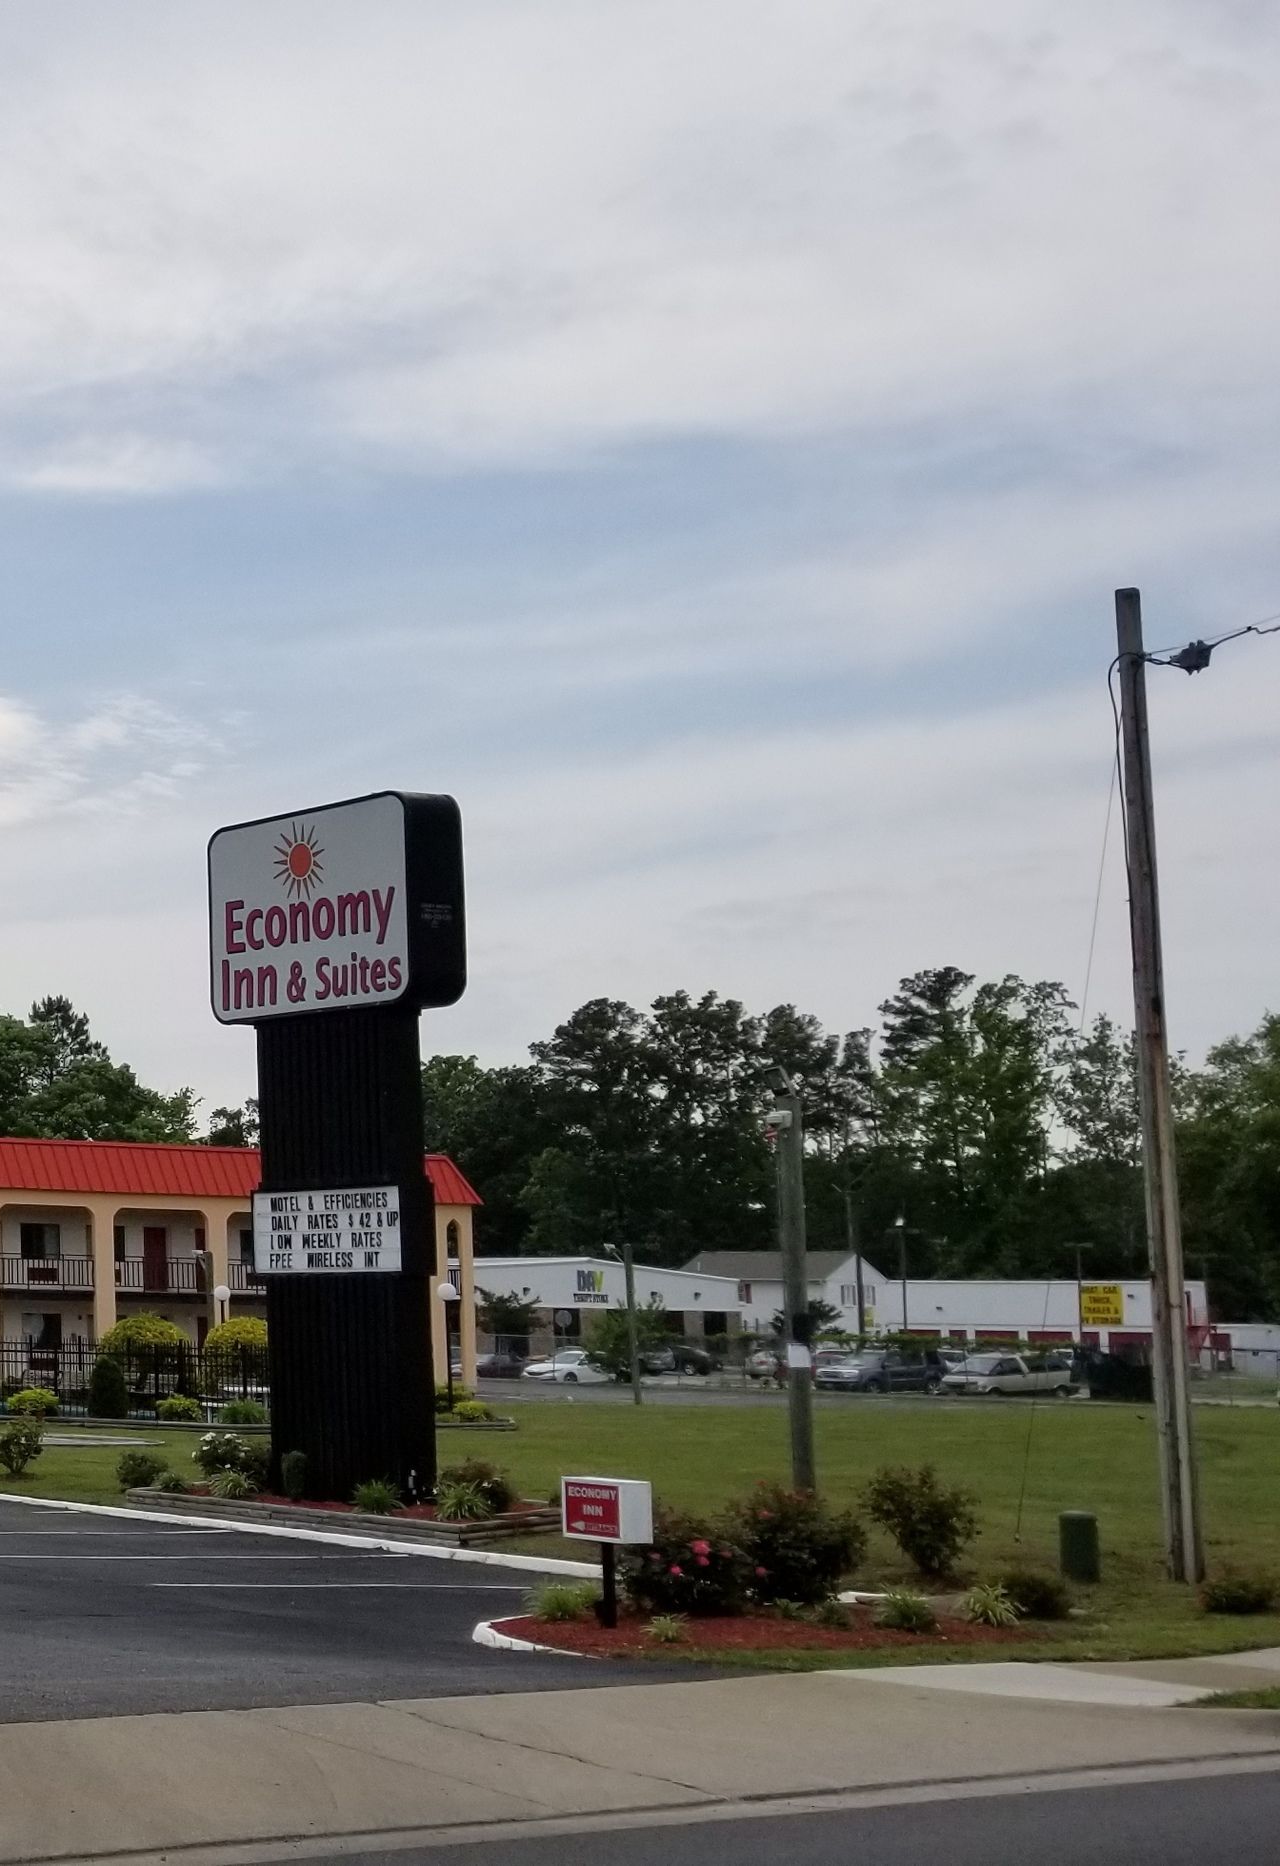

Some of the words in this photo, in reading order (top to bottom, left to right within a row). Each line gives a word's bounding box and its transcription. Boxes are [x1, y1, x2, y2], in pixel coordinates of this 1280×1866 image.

[225, 886, 395, 954] Economy
[222, 959, 277, 1011] Inn
[286, 961, 306, 1003] &
[315, 952, 402, 1000] Suites
[270, 1196, 301, 1212] MOTEL
[308, 1195, 314, 1211] &
[324, 1192, 388, 1210] EFFICIENCIES
[271, 1215, 298, 1231] DAILY
[307, 1213, 338, 1230] RATES
[386, 1211, 399, 1227] UP
[302, 1232, 342, 1249] WEEKLY
[351, 1231, 382, 1248] RATES
[307, 1251, 354, 1268] WIRELESS
[364, 1251, 380, 1268] INT
[568, 1486, 616, 1500] ECONOMY
[583, 1504, 603, 1517] INN
